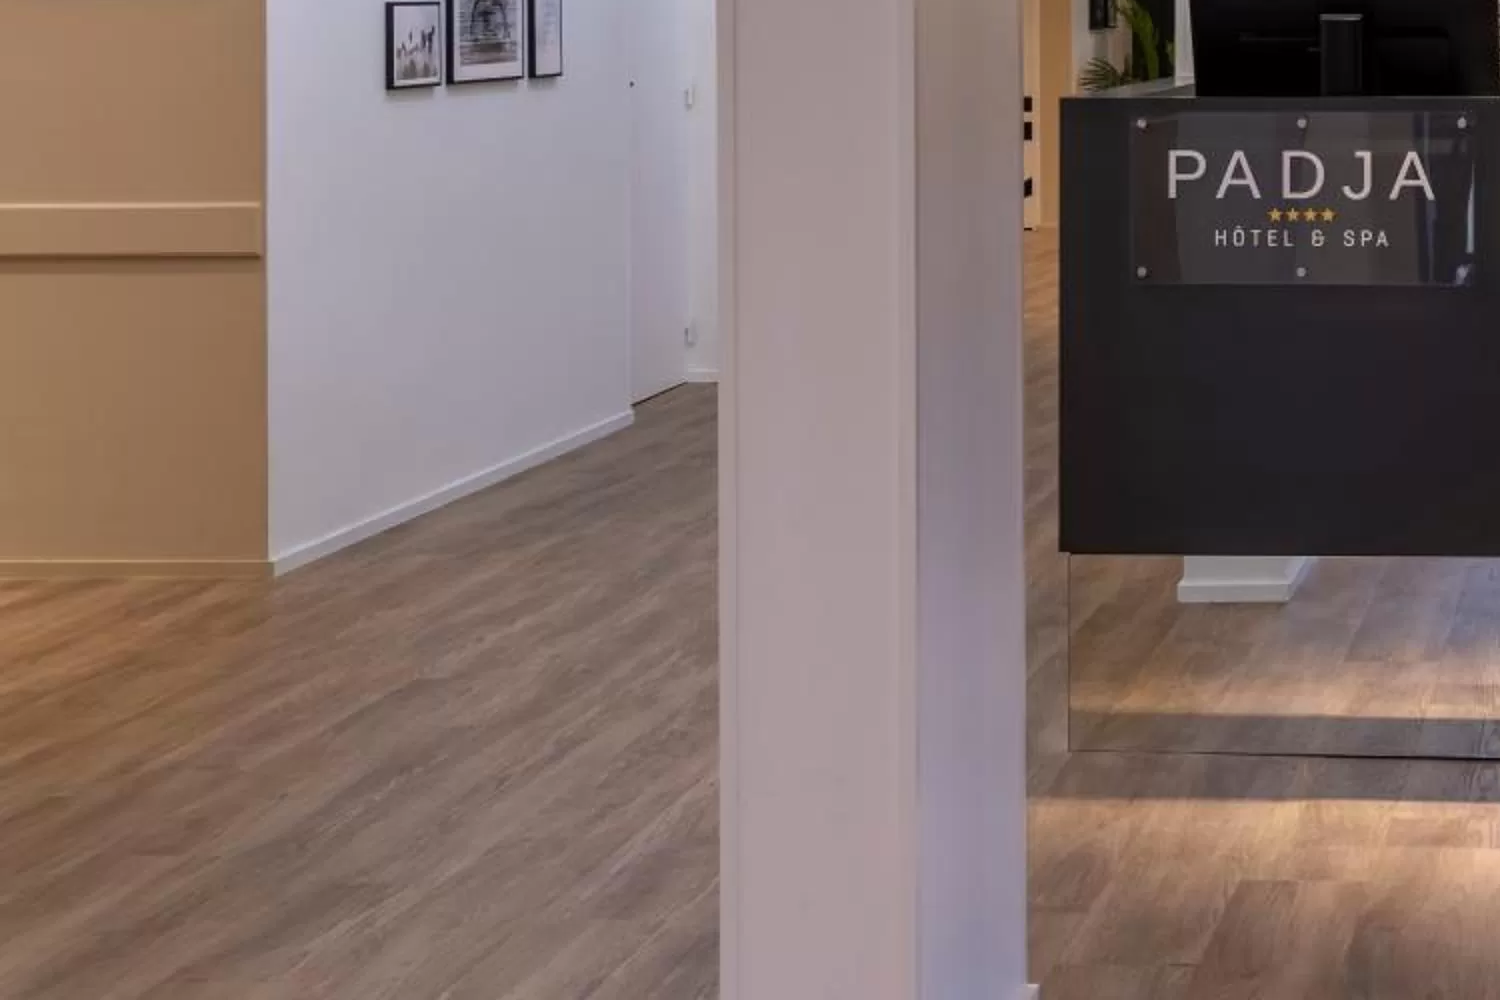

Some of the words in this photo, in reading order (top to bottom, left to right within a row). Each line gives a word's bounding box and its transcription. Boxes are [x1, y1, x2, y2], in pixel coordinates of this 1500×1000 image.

[1167, 149, 1436, 201] PADJA
[1214, 227, 1294, 247] HÔTEL
[1311, 229, 1326, 247] &
[1343, 229, 1390, 247] SPA
